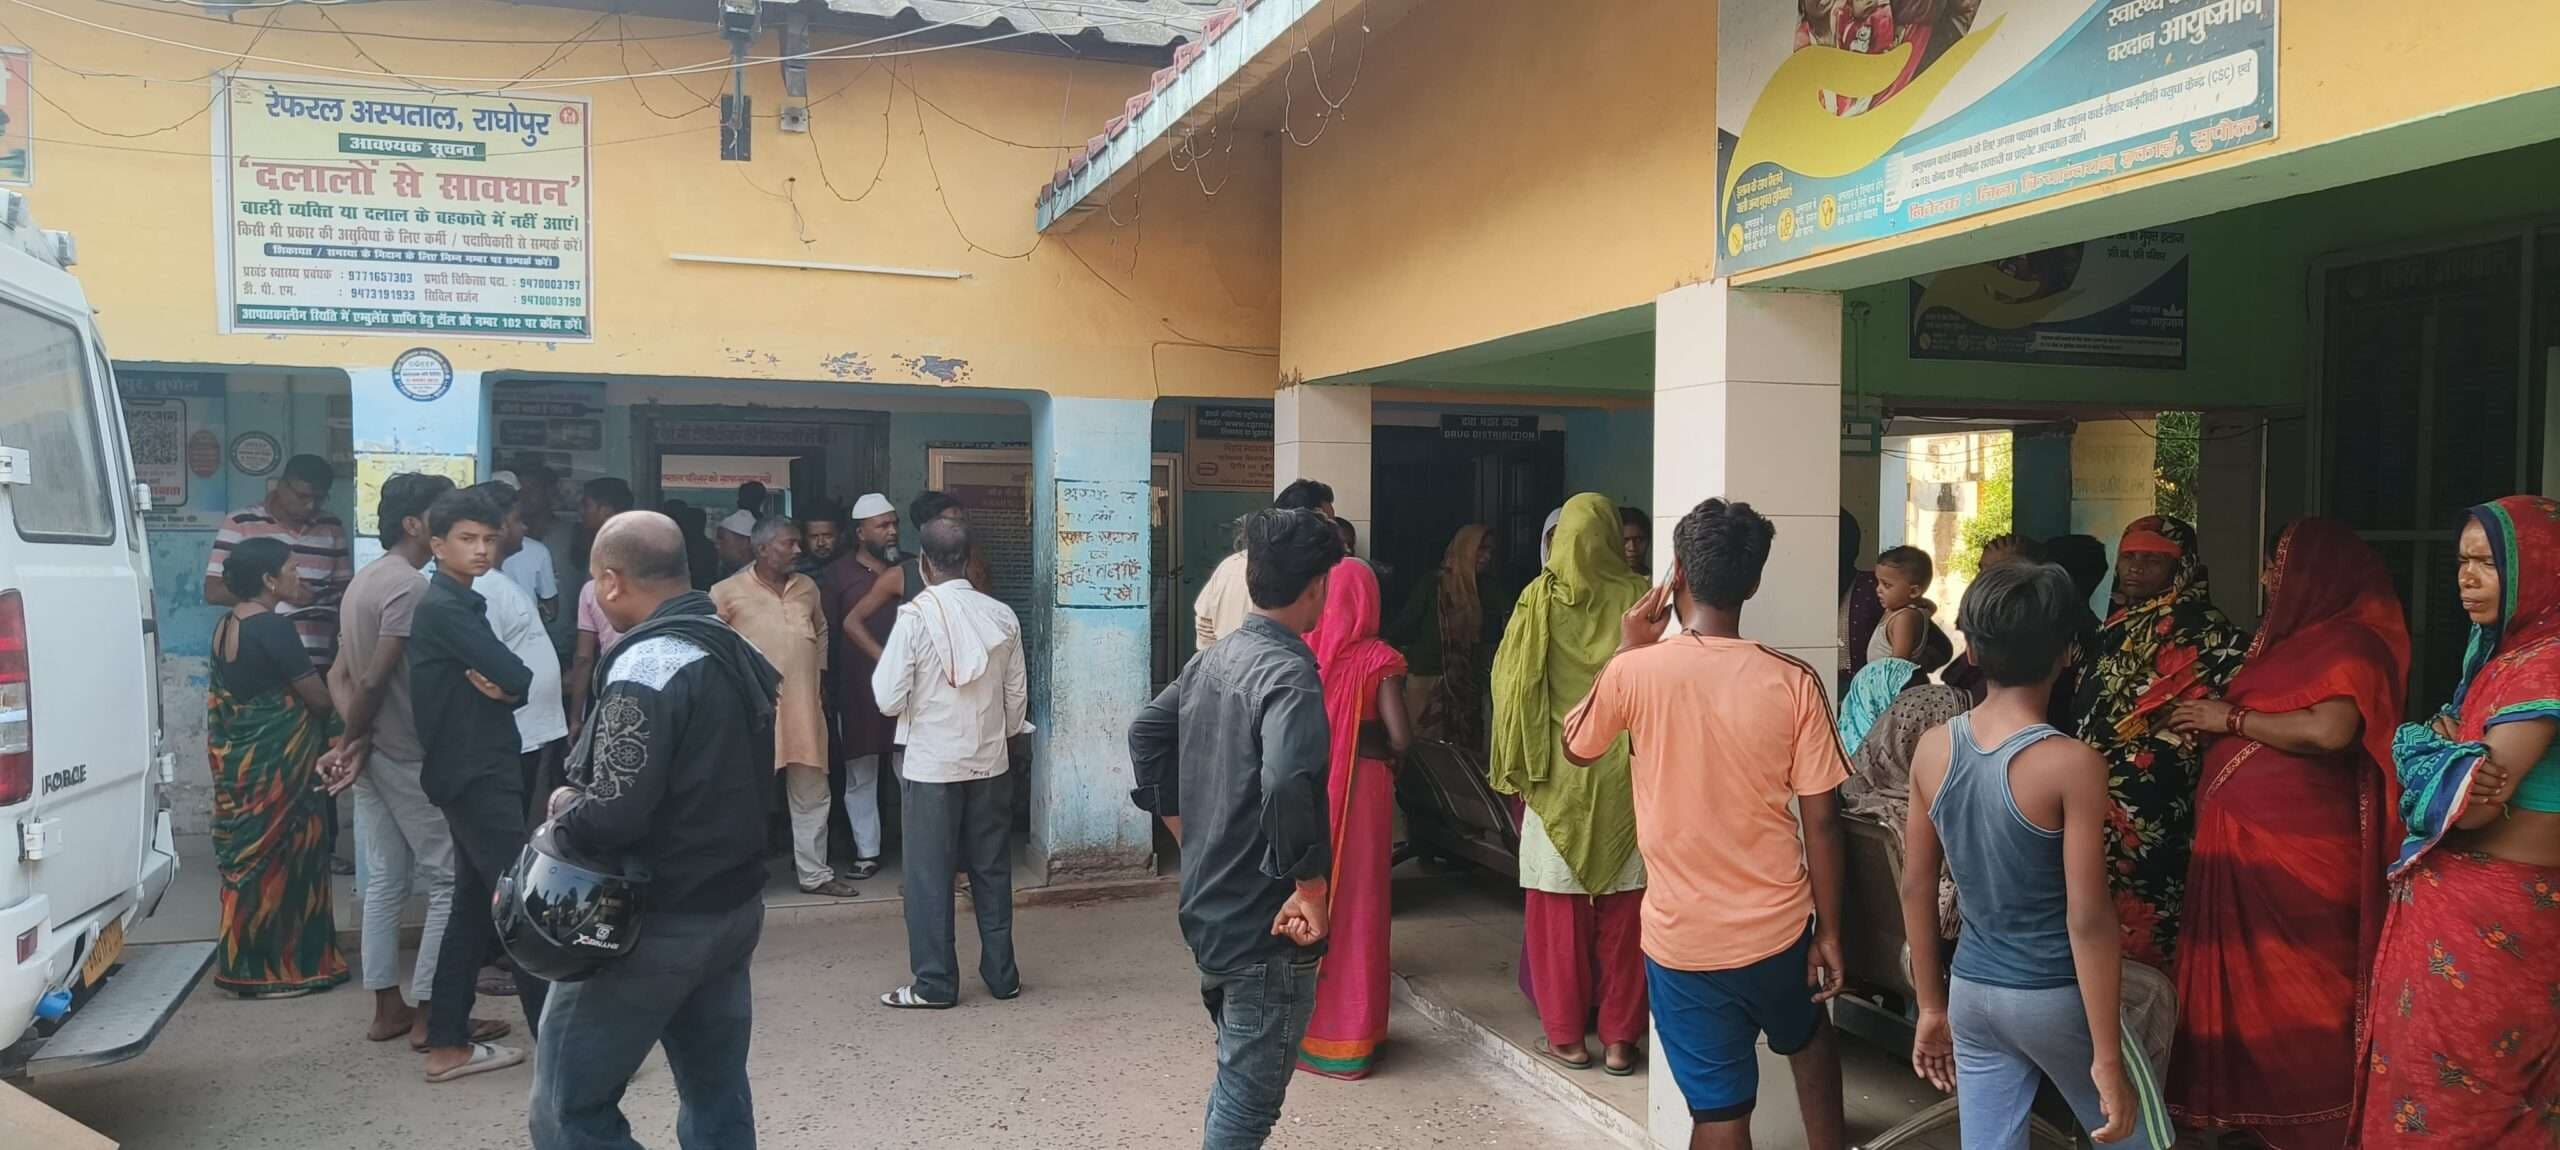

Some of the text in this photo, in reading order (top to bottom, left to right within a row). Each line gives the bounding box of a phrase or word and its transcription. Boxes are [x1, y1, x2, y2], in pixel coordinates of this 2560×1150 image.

[2107, 0, 2262, 62] वरदान आयुष्मान
[2208, 64, 2236, 88] (CSC)
[265, 85, 551, 147] रेफरल अस्पताल, राघोपुर
[350, 137, 476, 158] आवश्यक सूचना
[390, 163, 424, 198] से
[288, 201, 334, 219] व्यक्ति
[339, 205, 358, 220] या
[363, 207, 408, 223] दलाल
[414, 206, 431, 224] के
[436, 209, 486, 227] बहकावे
[491, 211, 506, 228] में
[511, 213, 539, 229] नहीं
[237, 220, 266, 237] किसी
[270, 221, 282, 238] भी
[287, 225, 316, 240] प्रकार
[319, 224, 334, 241] की
[338, 226, 380, 246] असुविधा
[384, 227, 396, 242] के
[399, 228, 420, 244] लिए
[424, 230, 448, 246] कर्मी
[462, 232, 513, 249] पदाधिकारी
[517, 234, 527, 250] से
[502, 316, 521, 329] 102
[523, 317, 538, 330] पर
[1443, 430, 1470, 440] DRUG
[45, 764, 87, 792] FORCE
